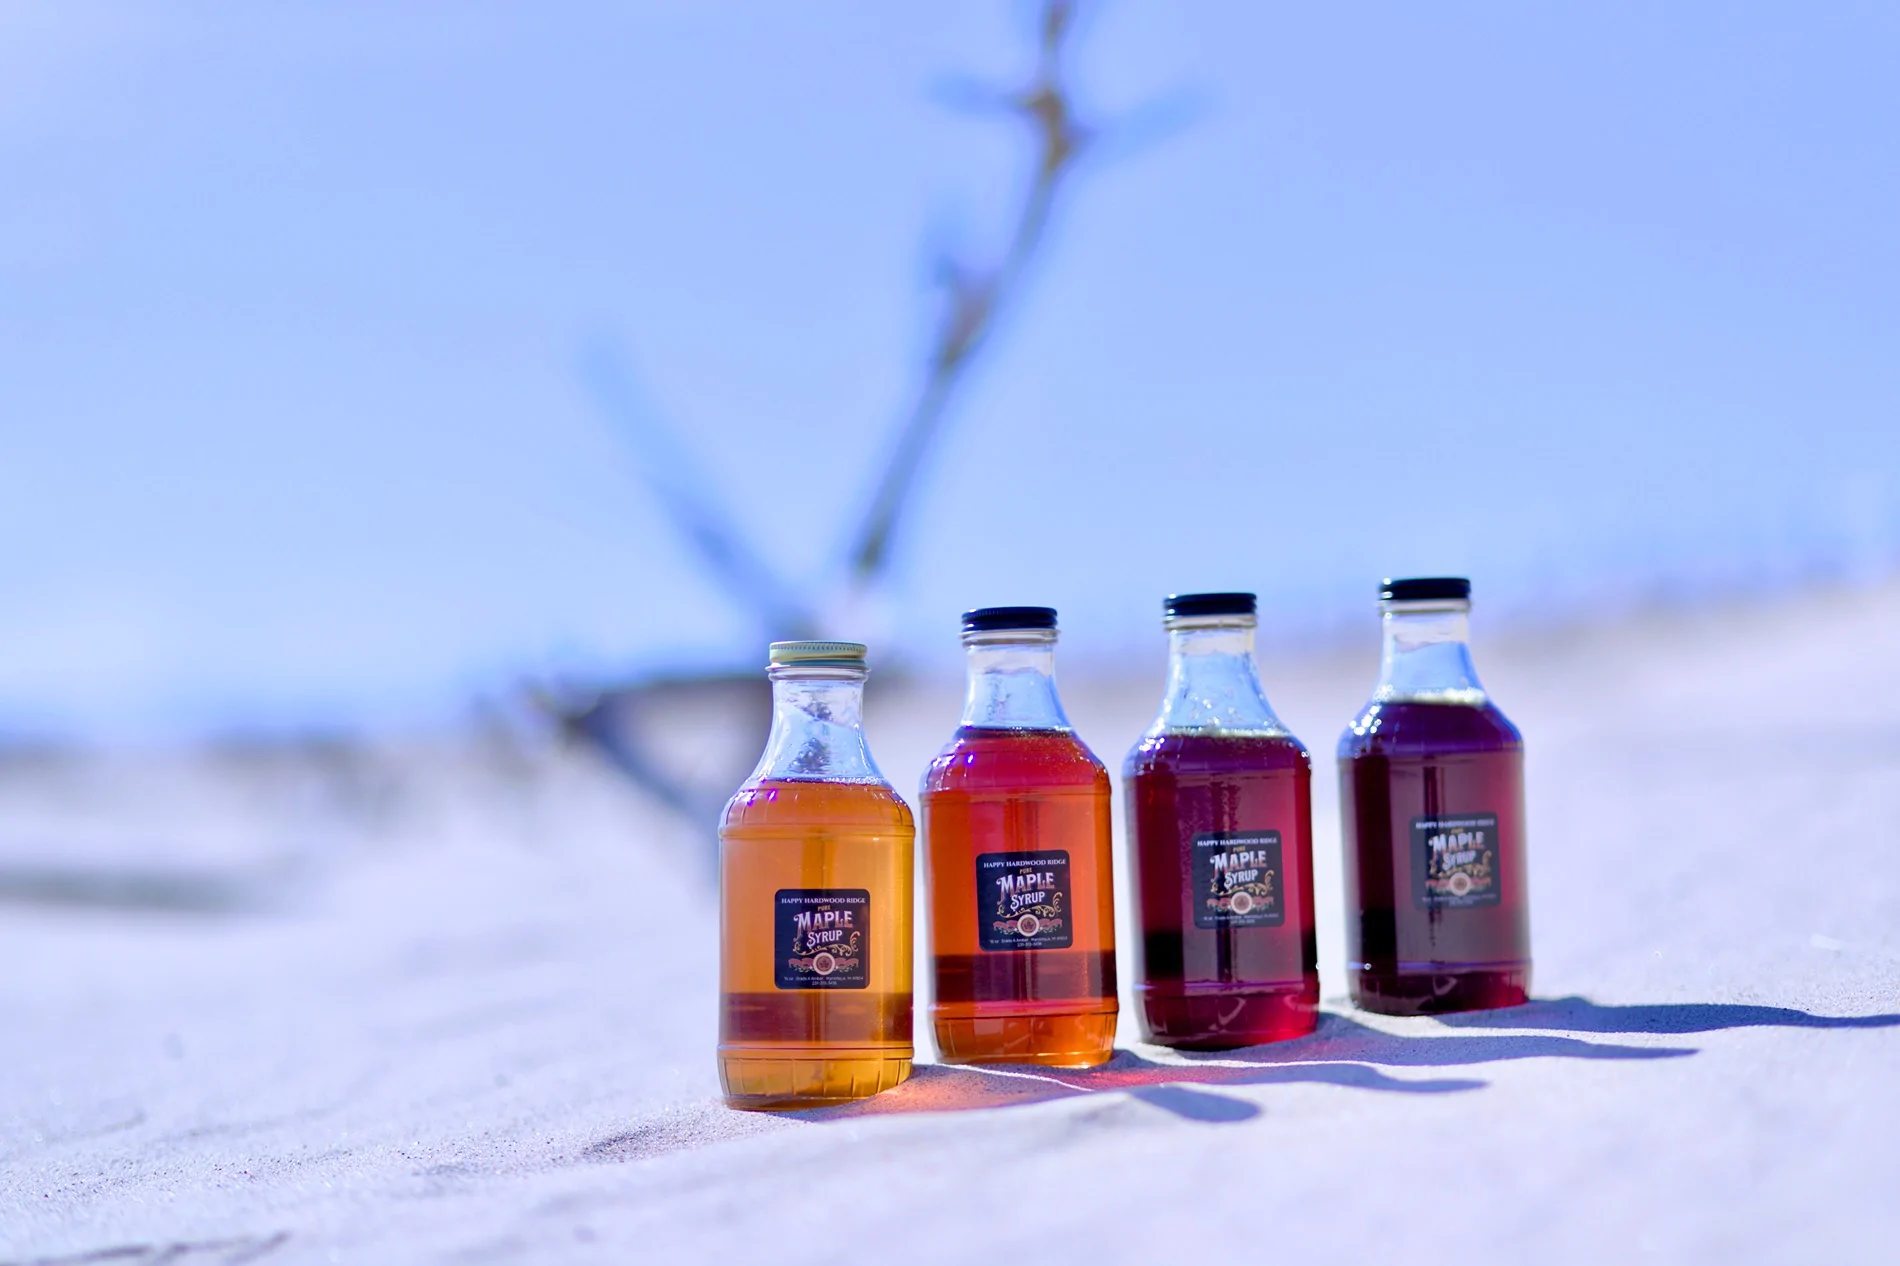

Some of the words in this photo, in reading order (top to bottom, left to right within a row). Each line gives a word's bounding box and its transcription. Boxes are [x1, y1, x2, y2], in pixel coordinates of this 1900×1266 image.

[1428, 831, 1485, 865] MAPLE
[1209, 850, 1267, 882] MAPLE
[1224, 869, 1258, 890] SYRUP
[995, 872, 1055, 905] MAPLE
[1010, 891, 1045, 912] SYRUP
[793, 910, 853, 942] MAPLE
[806, 930, 843, 949] SYRUP
